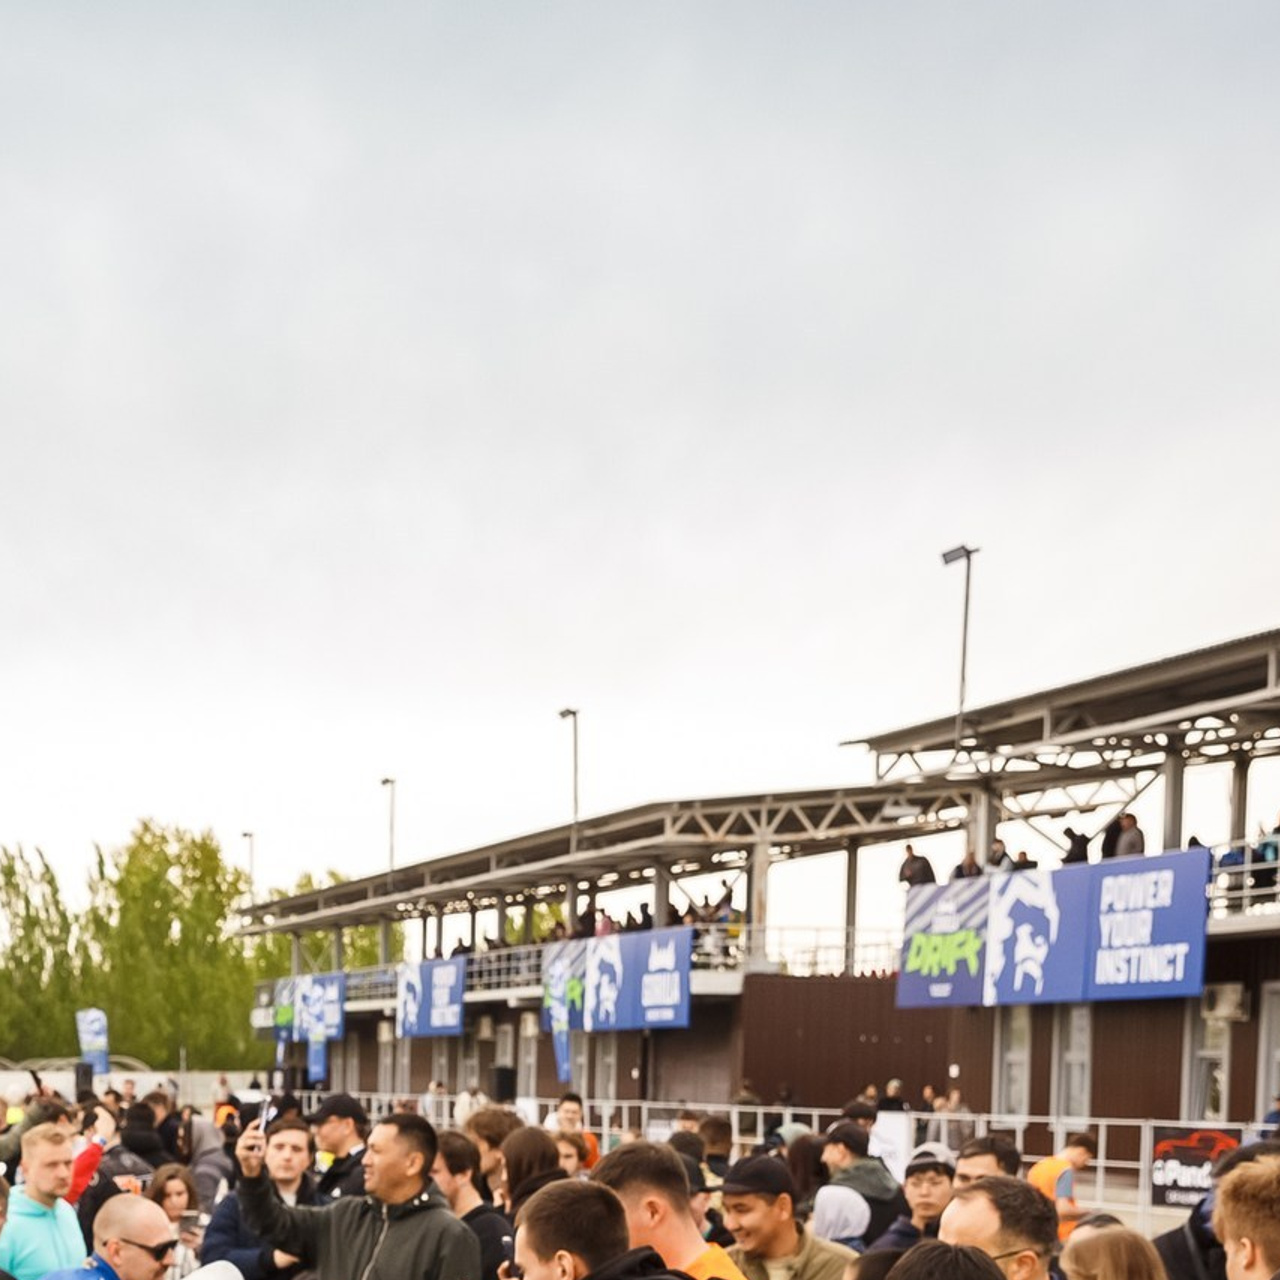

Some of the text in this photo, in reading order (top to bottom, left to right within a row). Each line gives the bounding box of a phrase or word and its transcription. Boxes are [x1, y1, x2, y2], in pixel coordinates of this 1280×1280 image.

[1100, 869, 1175, 911] POWER
[1099, 910, 1154, 947] YOUR
[1095, 942, 1191, 985] INSTINCT
